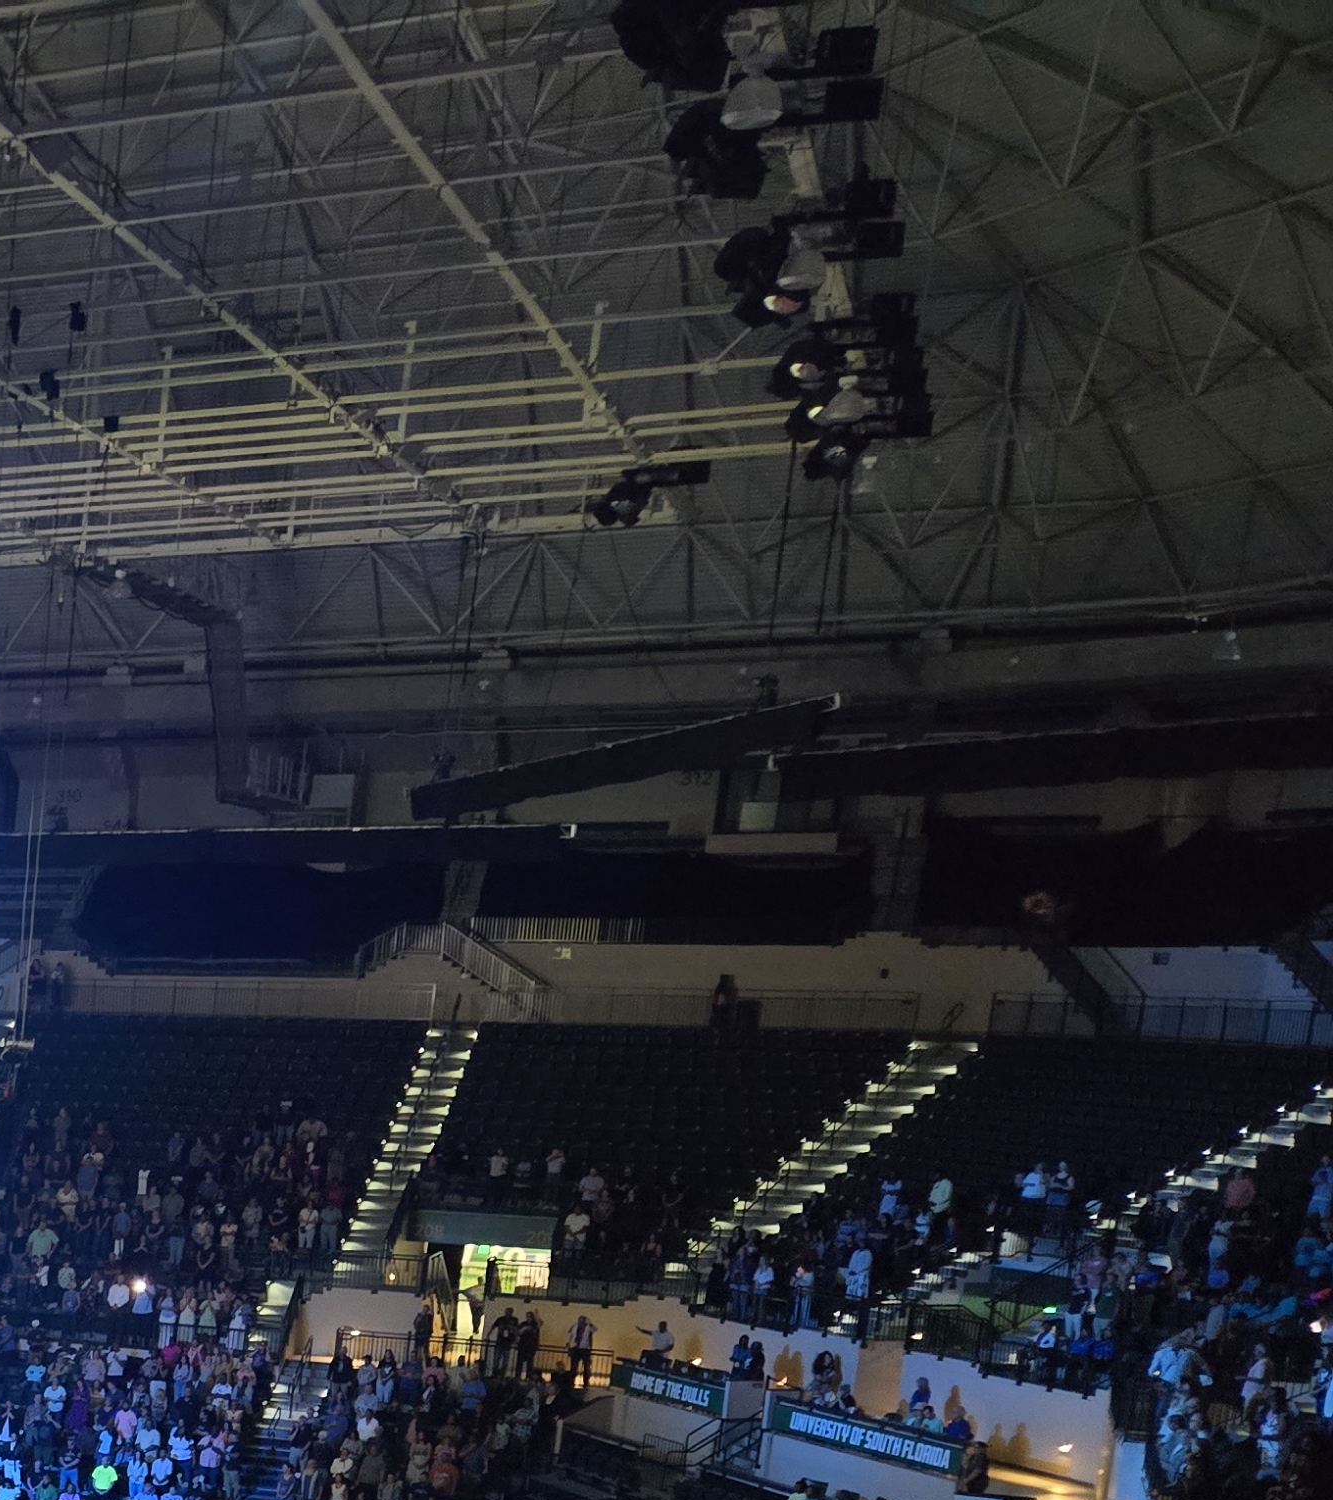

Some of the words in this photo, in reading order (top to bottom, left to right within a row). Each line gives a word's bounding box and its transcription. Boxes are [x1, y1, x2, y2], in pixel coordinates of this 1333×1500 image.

[680, 771, 712, 787] 312
[631, 1373, 653, 1393] HOME
[654, 1378, 665, 1396] OF
[666, 1381, 682, 1401] THE
[682, 1386, 709, 1407] BULLS
[789, 1411, 850, 1442] UNIVERSITY
[850, 1426, 864, 1446] OF
[864, 1431, 900, 1458] SOUTH
[901, 1440, 950, 1469] FLORIDA
